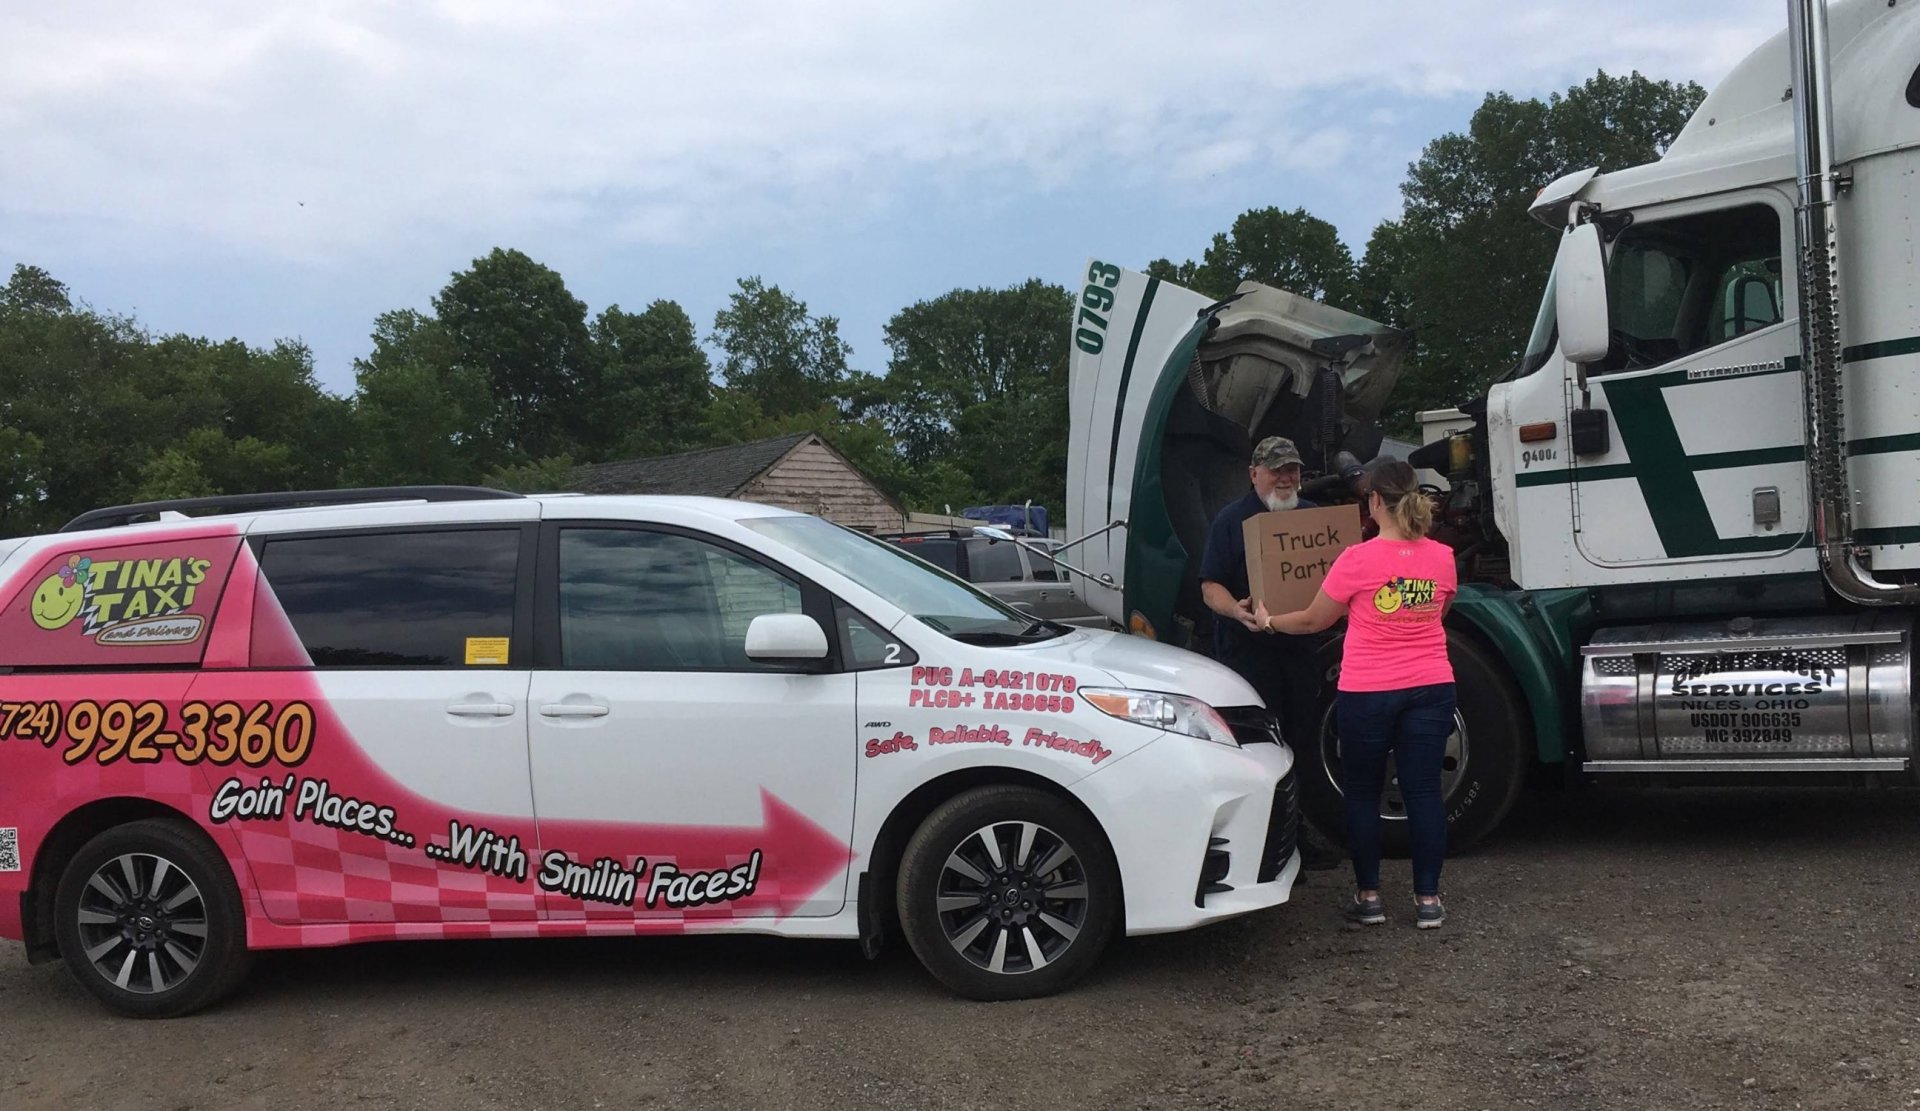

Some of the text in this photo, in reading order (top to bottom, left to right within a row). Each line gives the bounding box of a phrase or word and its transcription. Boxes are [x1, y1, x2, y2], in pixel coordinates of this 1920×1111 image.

[1076, 260, 1120, 355] 0793
[1689, 360, 1784, 379] INTERNATIONAL
[1273, 525, 1340, 551] Truck
[88, 556, 211, 591] TINA'S
[1280, 558, 1335, 581] Part
[1403, 579, 1438, 592] TINA'S
[91, 585, 196, 623] TAXI
[1405, 591, 1435, 604] TAXI
[104, 624, 196, 640] and Delivery
[884, 644, 901, 664] 2
[911, 666, 1076, 694] PUC A-6421079
[1671, 682, 1823, 697] SERVICES
[909, 689, 976, 708] PLCB+
[1681, 698, 1810, 711] NILES, OHIO
[1690, 712, 1801, 728] USDOT 906635
[0, 699, 315, 765] 724) 992-3360
[1705, 728, 1792, 743] MC 392849
[865, 725, 1112, 764] Safe, Reliable, Friendly
[210, 774, 763, 908] Goin' Places... ...With Smilin' Faces!
